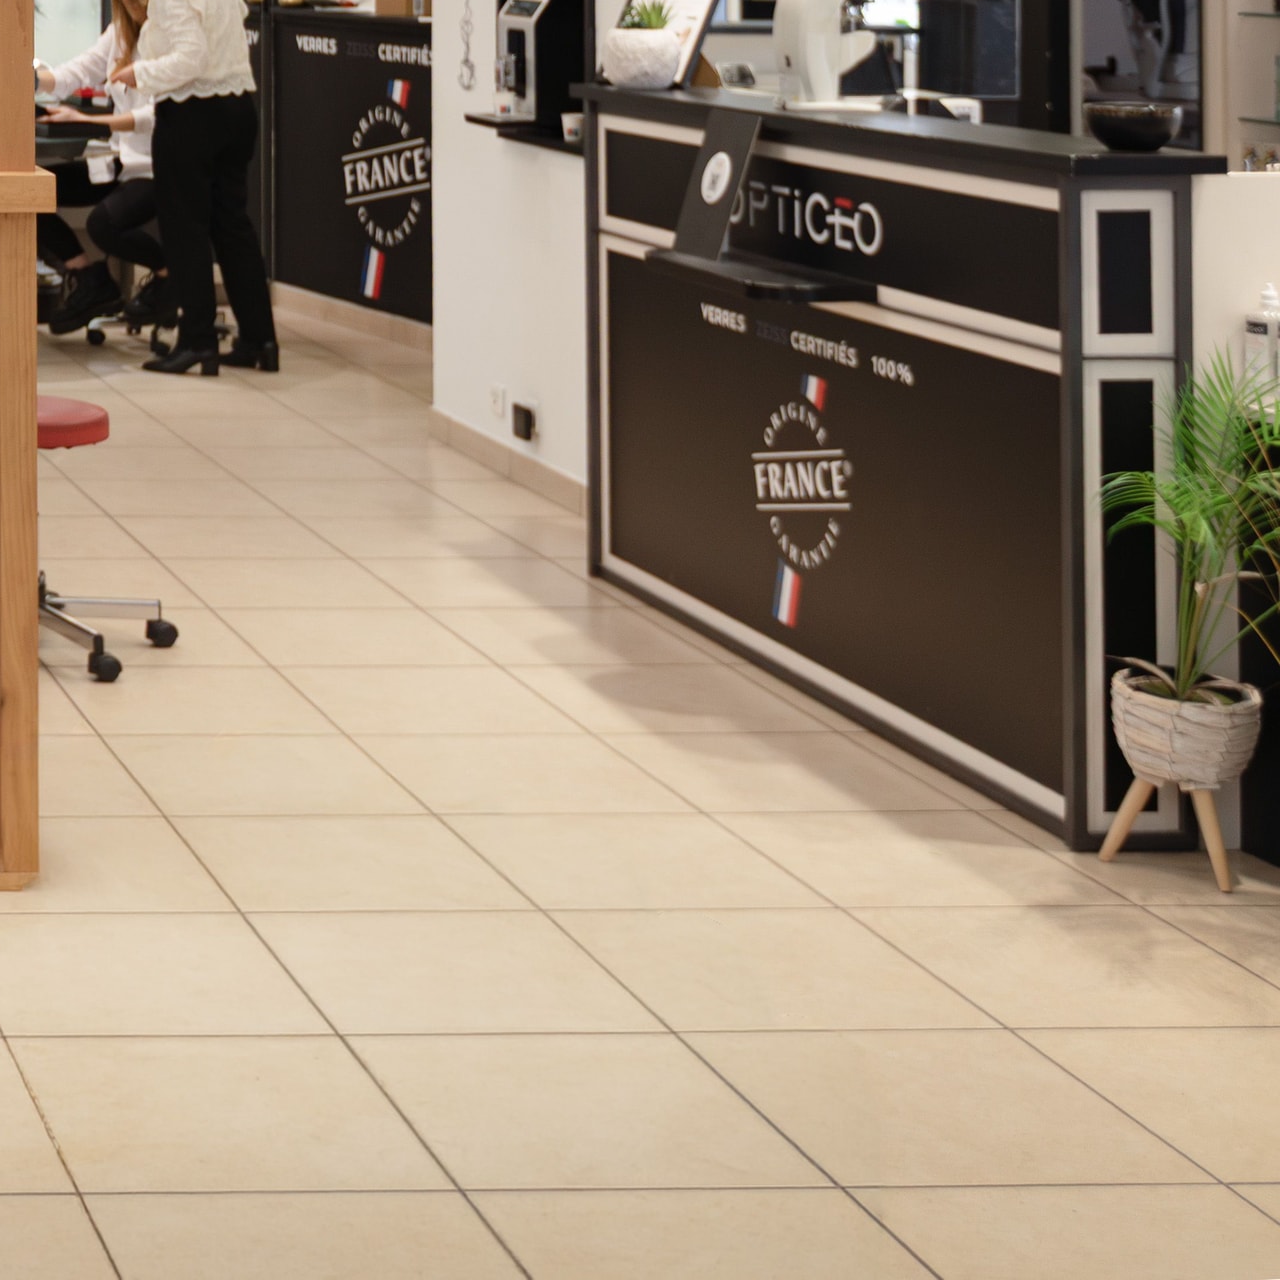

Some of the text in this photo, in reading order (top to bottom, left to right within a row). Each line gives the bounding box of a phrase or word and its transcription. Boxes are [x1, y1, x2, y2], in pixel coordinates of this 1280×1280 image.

[295, 34, 338, 56] VERRES
[352, 104, 411, 149] ORIGINE
[343, 146, 428, 195] FRANCE
[700, 301, 748, 333] VERRES
[790, 330, 859, 369] CERTIFIÉS
[871, 355, 915, 387] 100%
[763, 401, 828, 448] ORIGINE
[753, 460, 848, 500] FRANCE
[769, 515, 840, 570] GARANTIE
